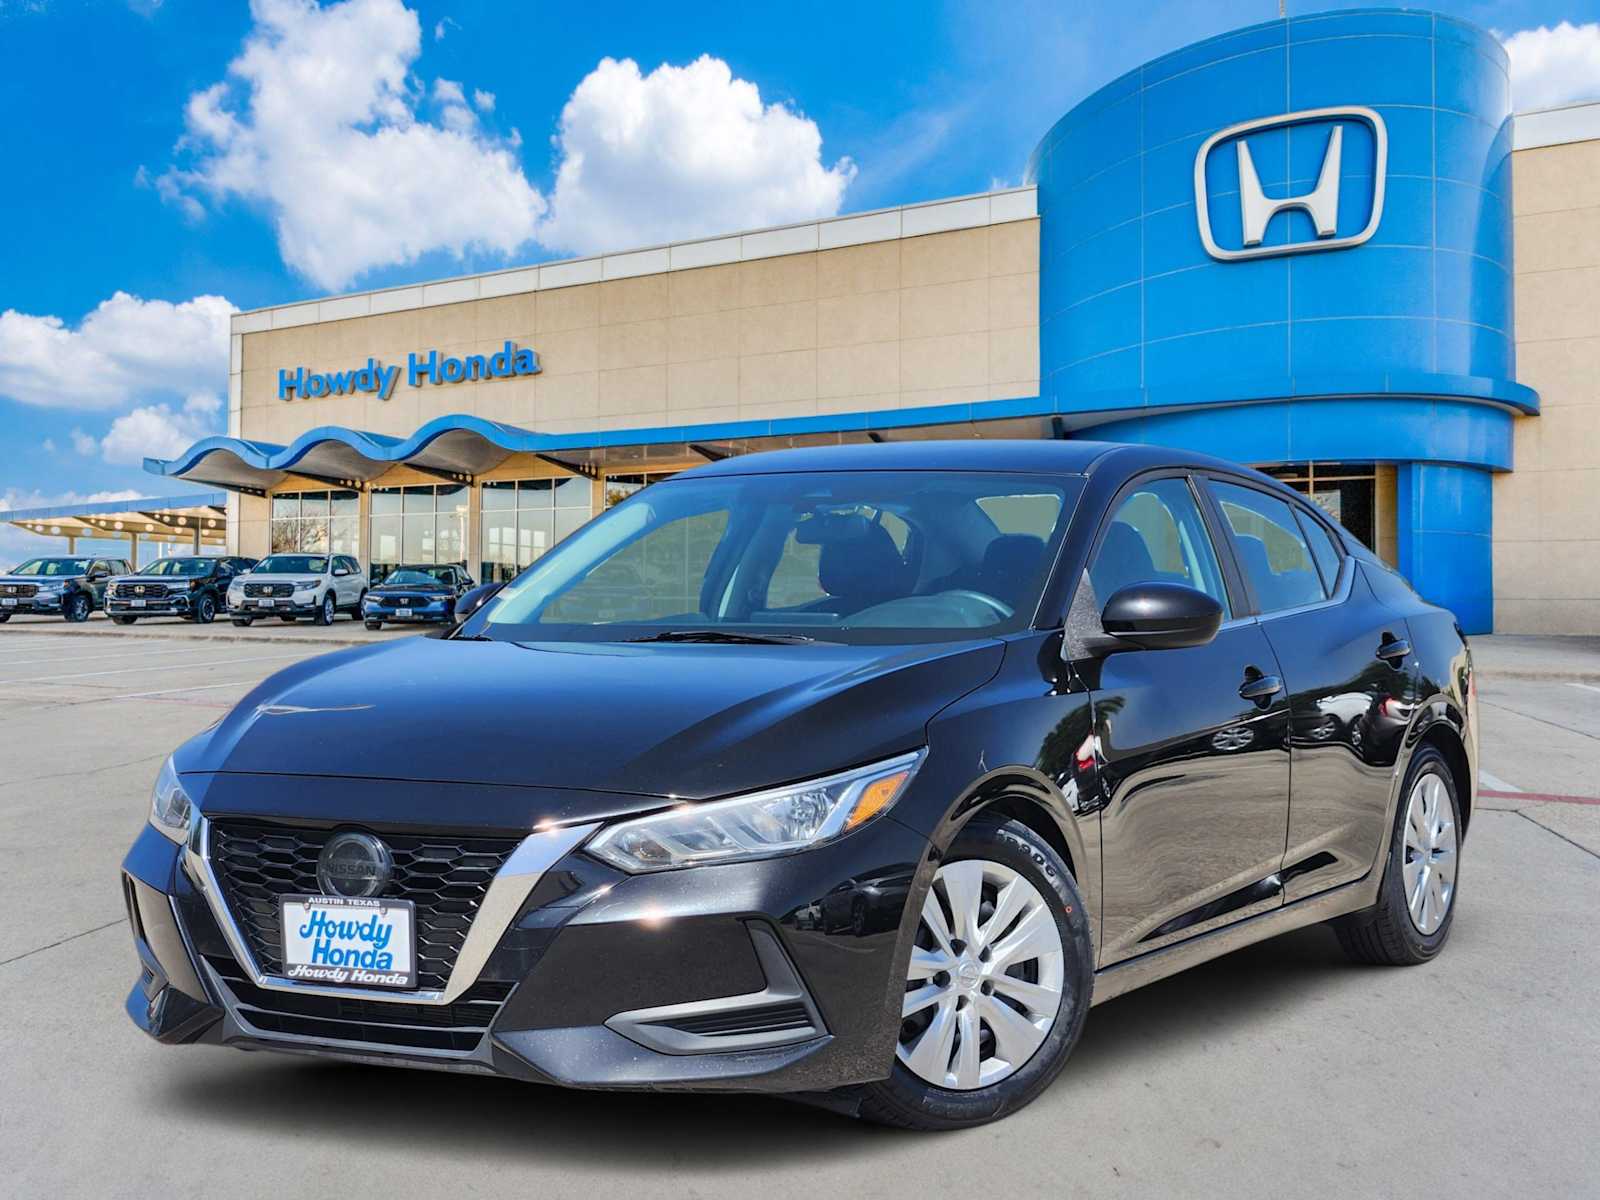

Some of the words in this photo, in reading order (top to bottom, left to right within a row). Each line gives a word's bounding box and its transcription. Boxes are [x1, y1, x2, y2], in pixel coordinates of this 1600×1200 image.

[278, 357, 400, 401] Howdy
[407, 340, 541, 386] Honda
[308, 897, 344, 905] AUSTIN
[347, 899, 381, 907] TEXAS
[299, 910, 393, 950] Howdy
[311, 938, 393, 970] Honda
[288, 965, 348, 982] Howdy
[350, 970, 408, 985] Honda
